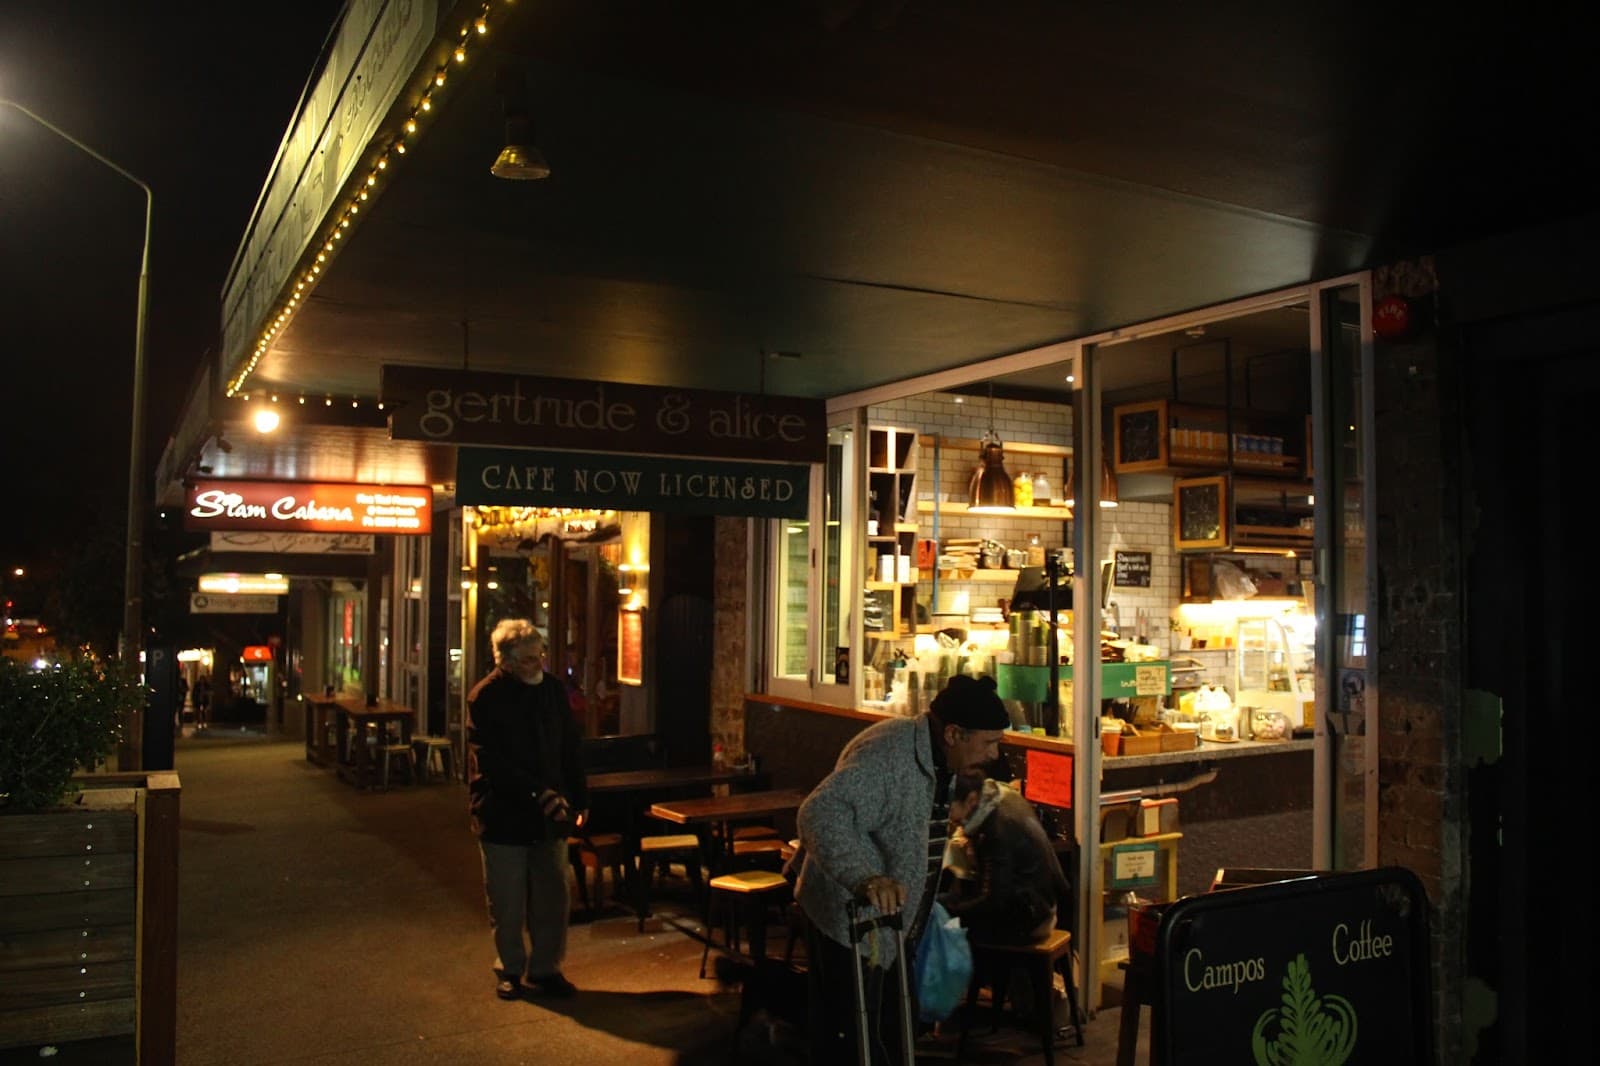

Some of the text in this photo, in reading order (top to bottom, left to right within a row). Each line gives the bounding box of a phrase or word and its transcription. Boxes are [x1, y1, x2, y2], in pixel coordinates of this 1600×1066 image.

[418, 380, 808, 442] gertrude & alice
[190, 489, 267, 519] Siam
[480, 464, 795, 502] CAFE NOW LICENSED
[1183, 919, 1393, 995] Campos Coffee
